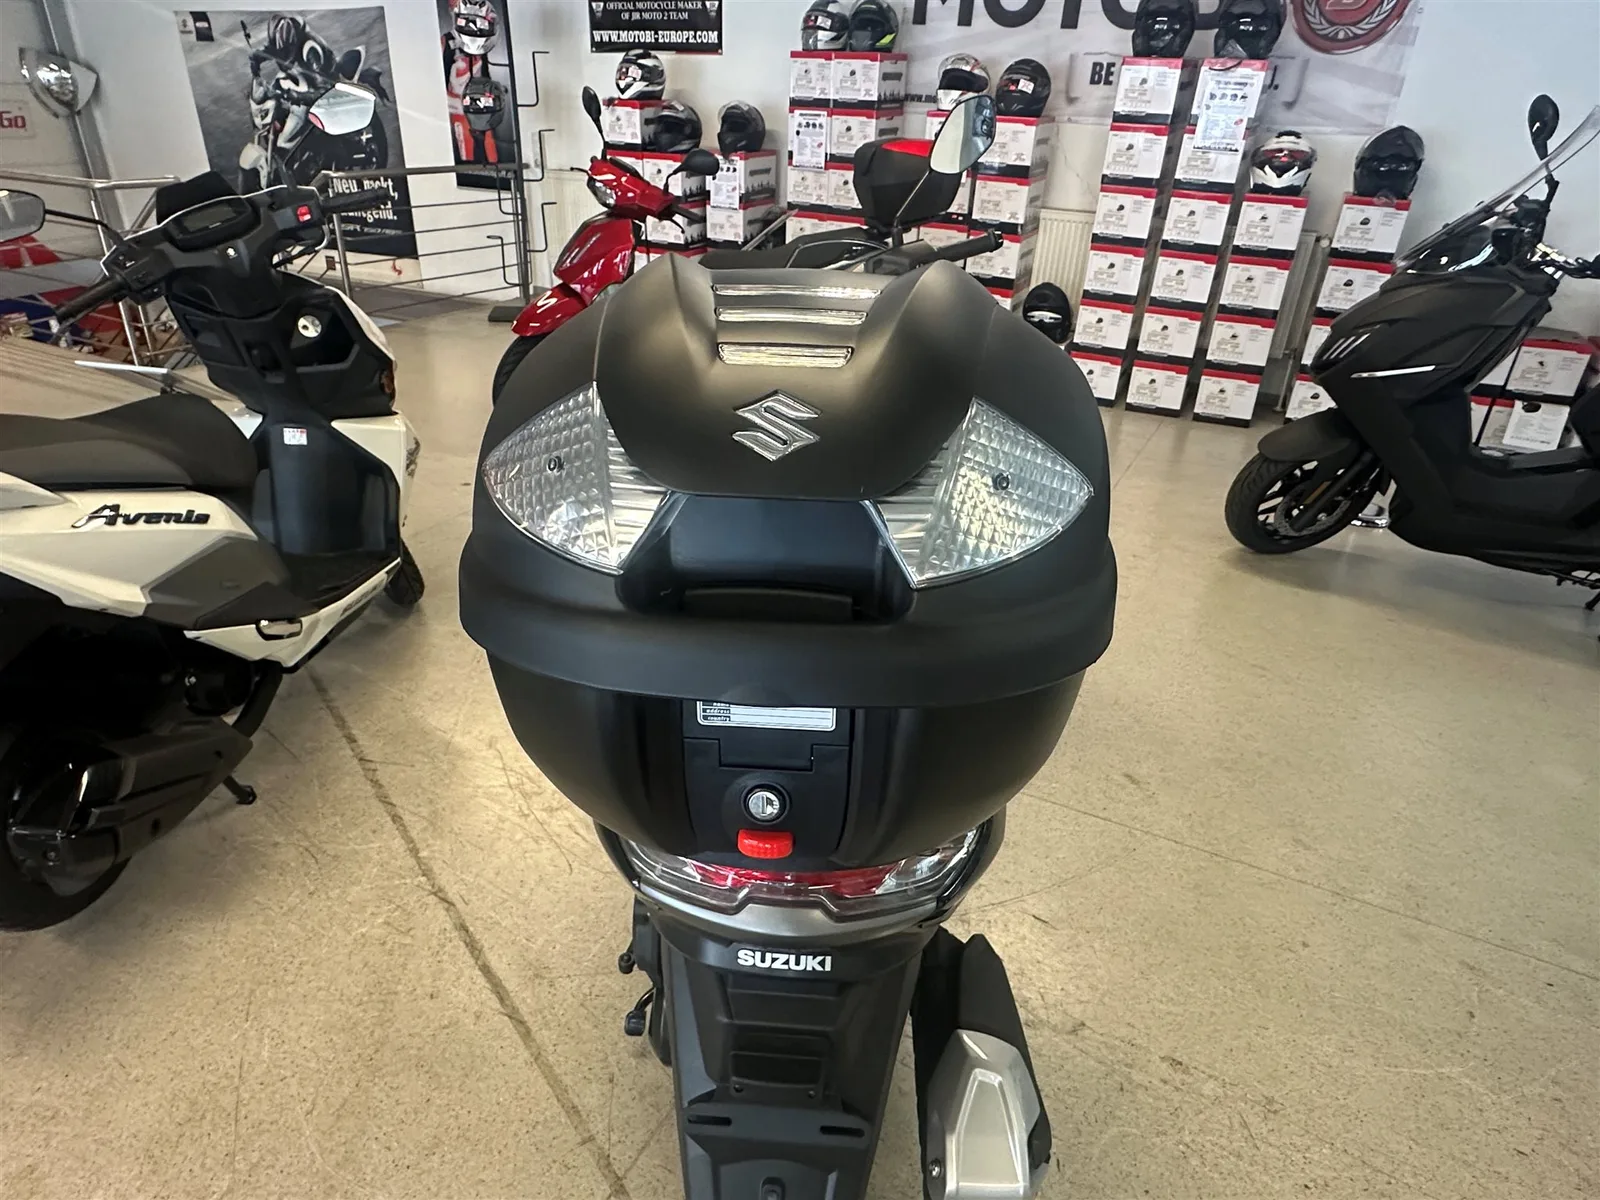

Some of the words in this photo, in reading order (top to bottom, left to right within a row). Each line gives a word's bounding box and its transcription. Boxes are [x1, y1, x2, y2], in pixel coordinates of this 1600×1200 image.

[606, 1, 634, 10] OFFICIAL
[636, 1, 676, 10] MOTOCYCLE
[677, 1, 702, 9] MAKER
[621, 12, 630, 20] OF
[642, 11, 663, 20] MOTO
[663, 11, 668, 20] 2
[669, 11, 689, 20] TEAM
[592, 30, 718, 43] WWW.MOTOBI-EUROPE.COM
[1090, 61, 1114, 86] BE
[71, 504, 211, 528] Avenis
[737, 949, 832, 972] SUZUKI
